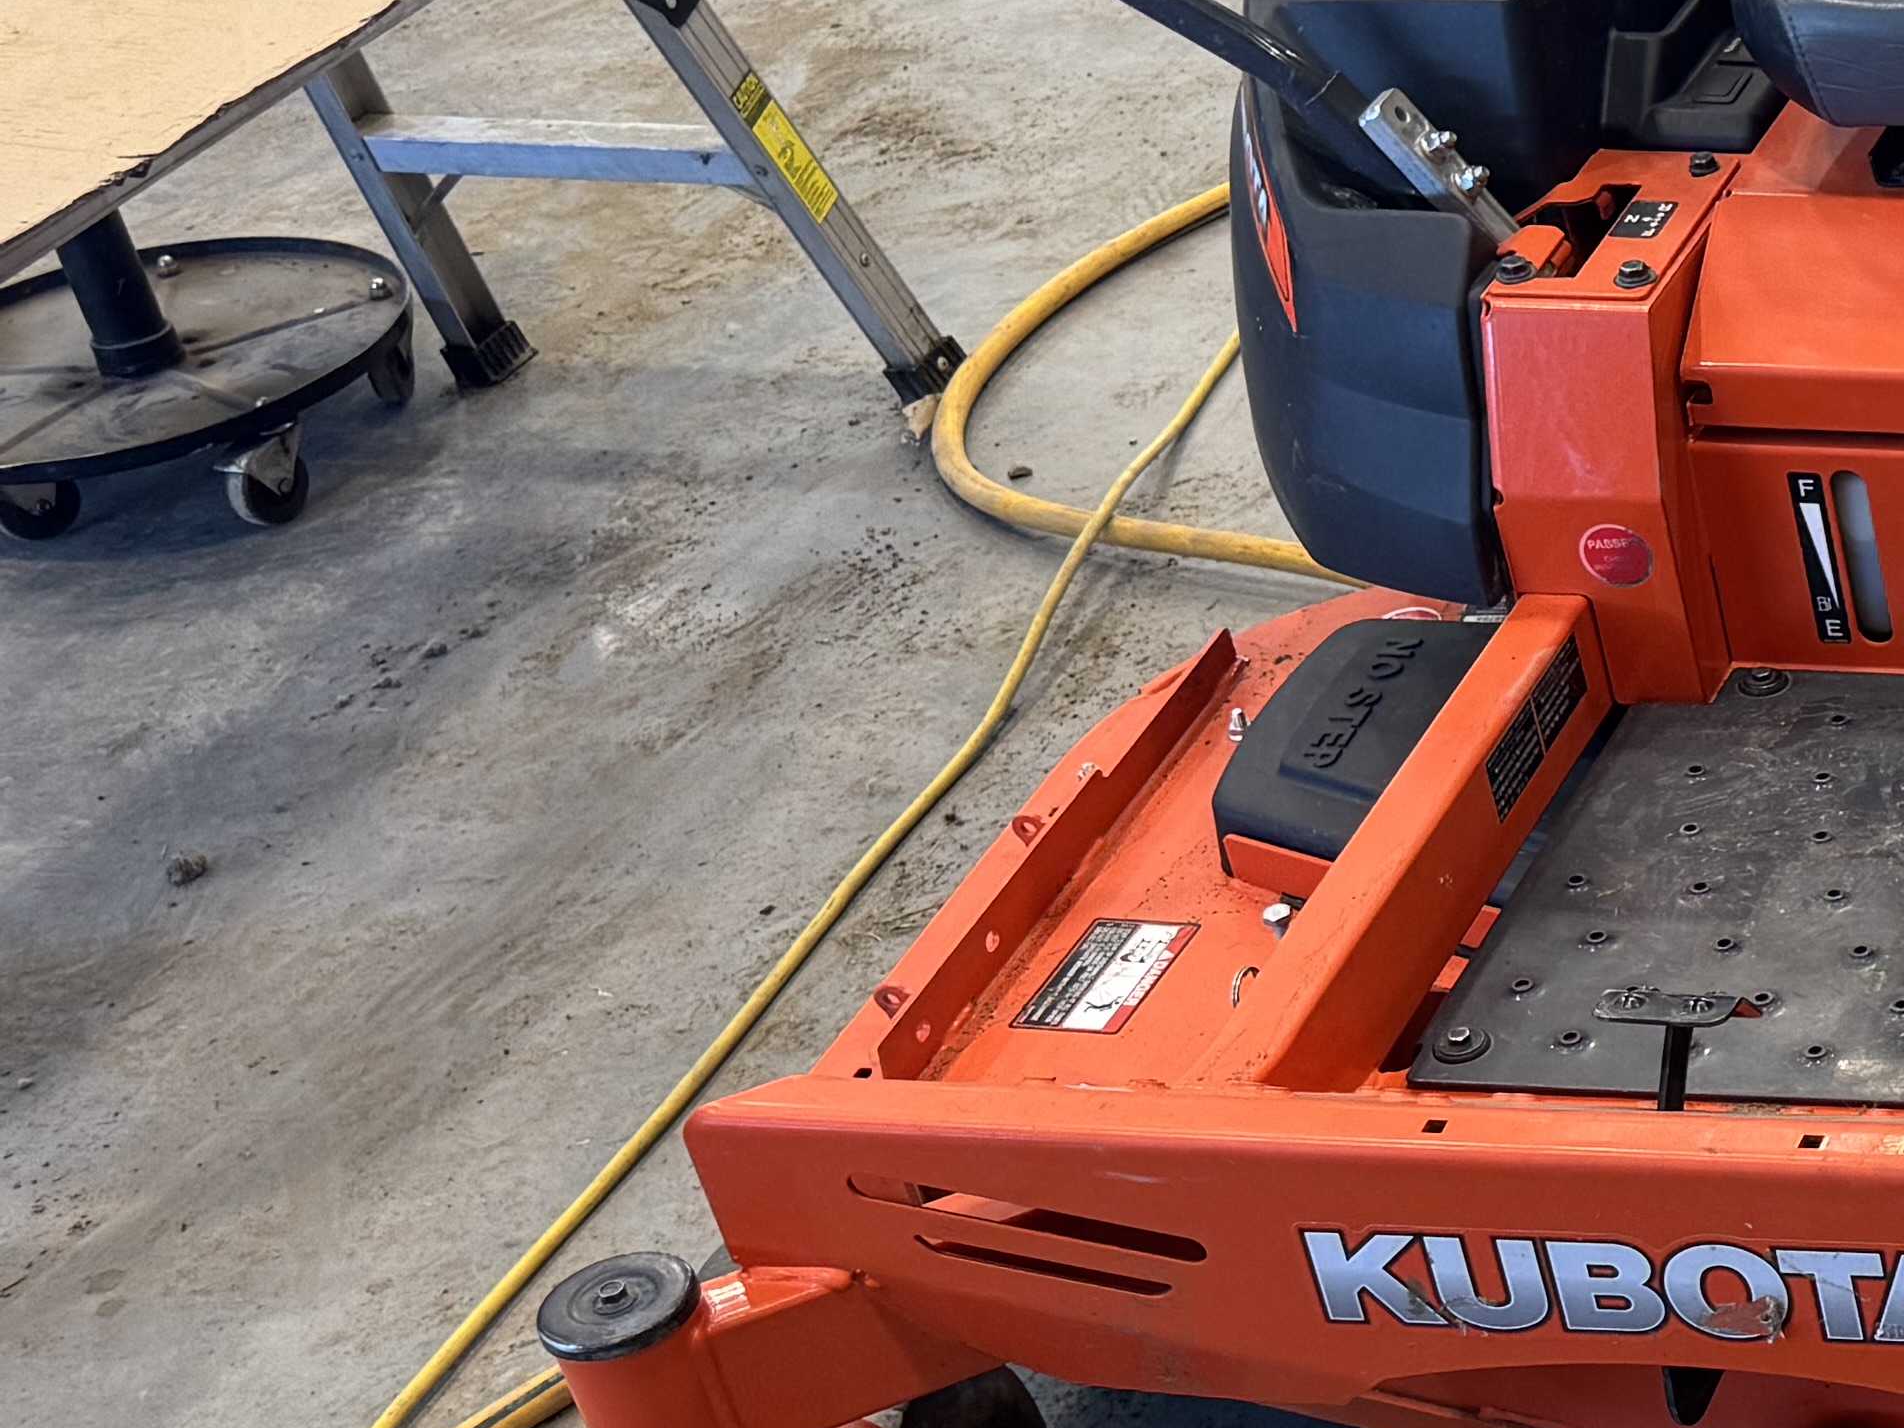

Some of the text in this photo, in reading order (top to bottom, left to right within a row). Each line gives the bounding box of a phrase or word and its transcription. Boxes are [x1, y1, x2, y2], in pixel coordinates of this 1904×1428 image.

[1798, 478, 1815, 498] F
[1825, 618, 1844, 637] E
[1123, 955, 1170, 1007] DANGER
